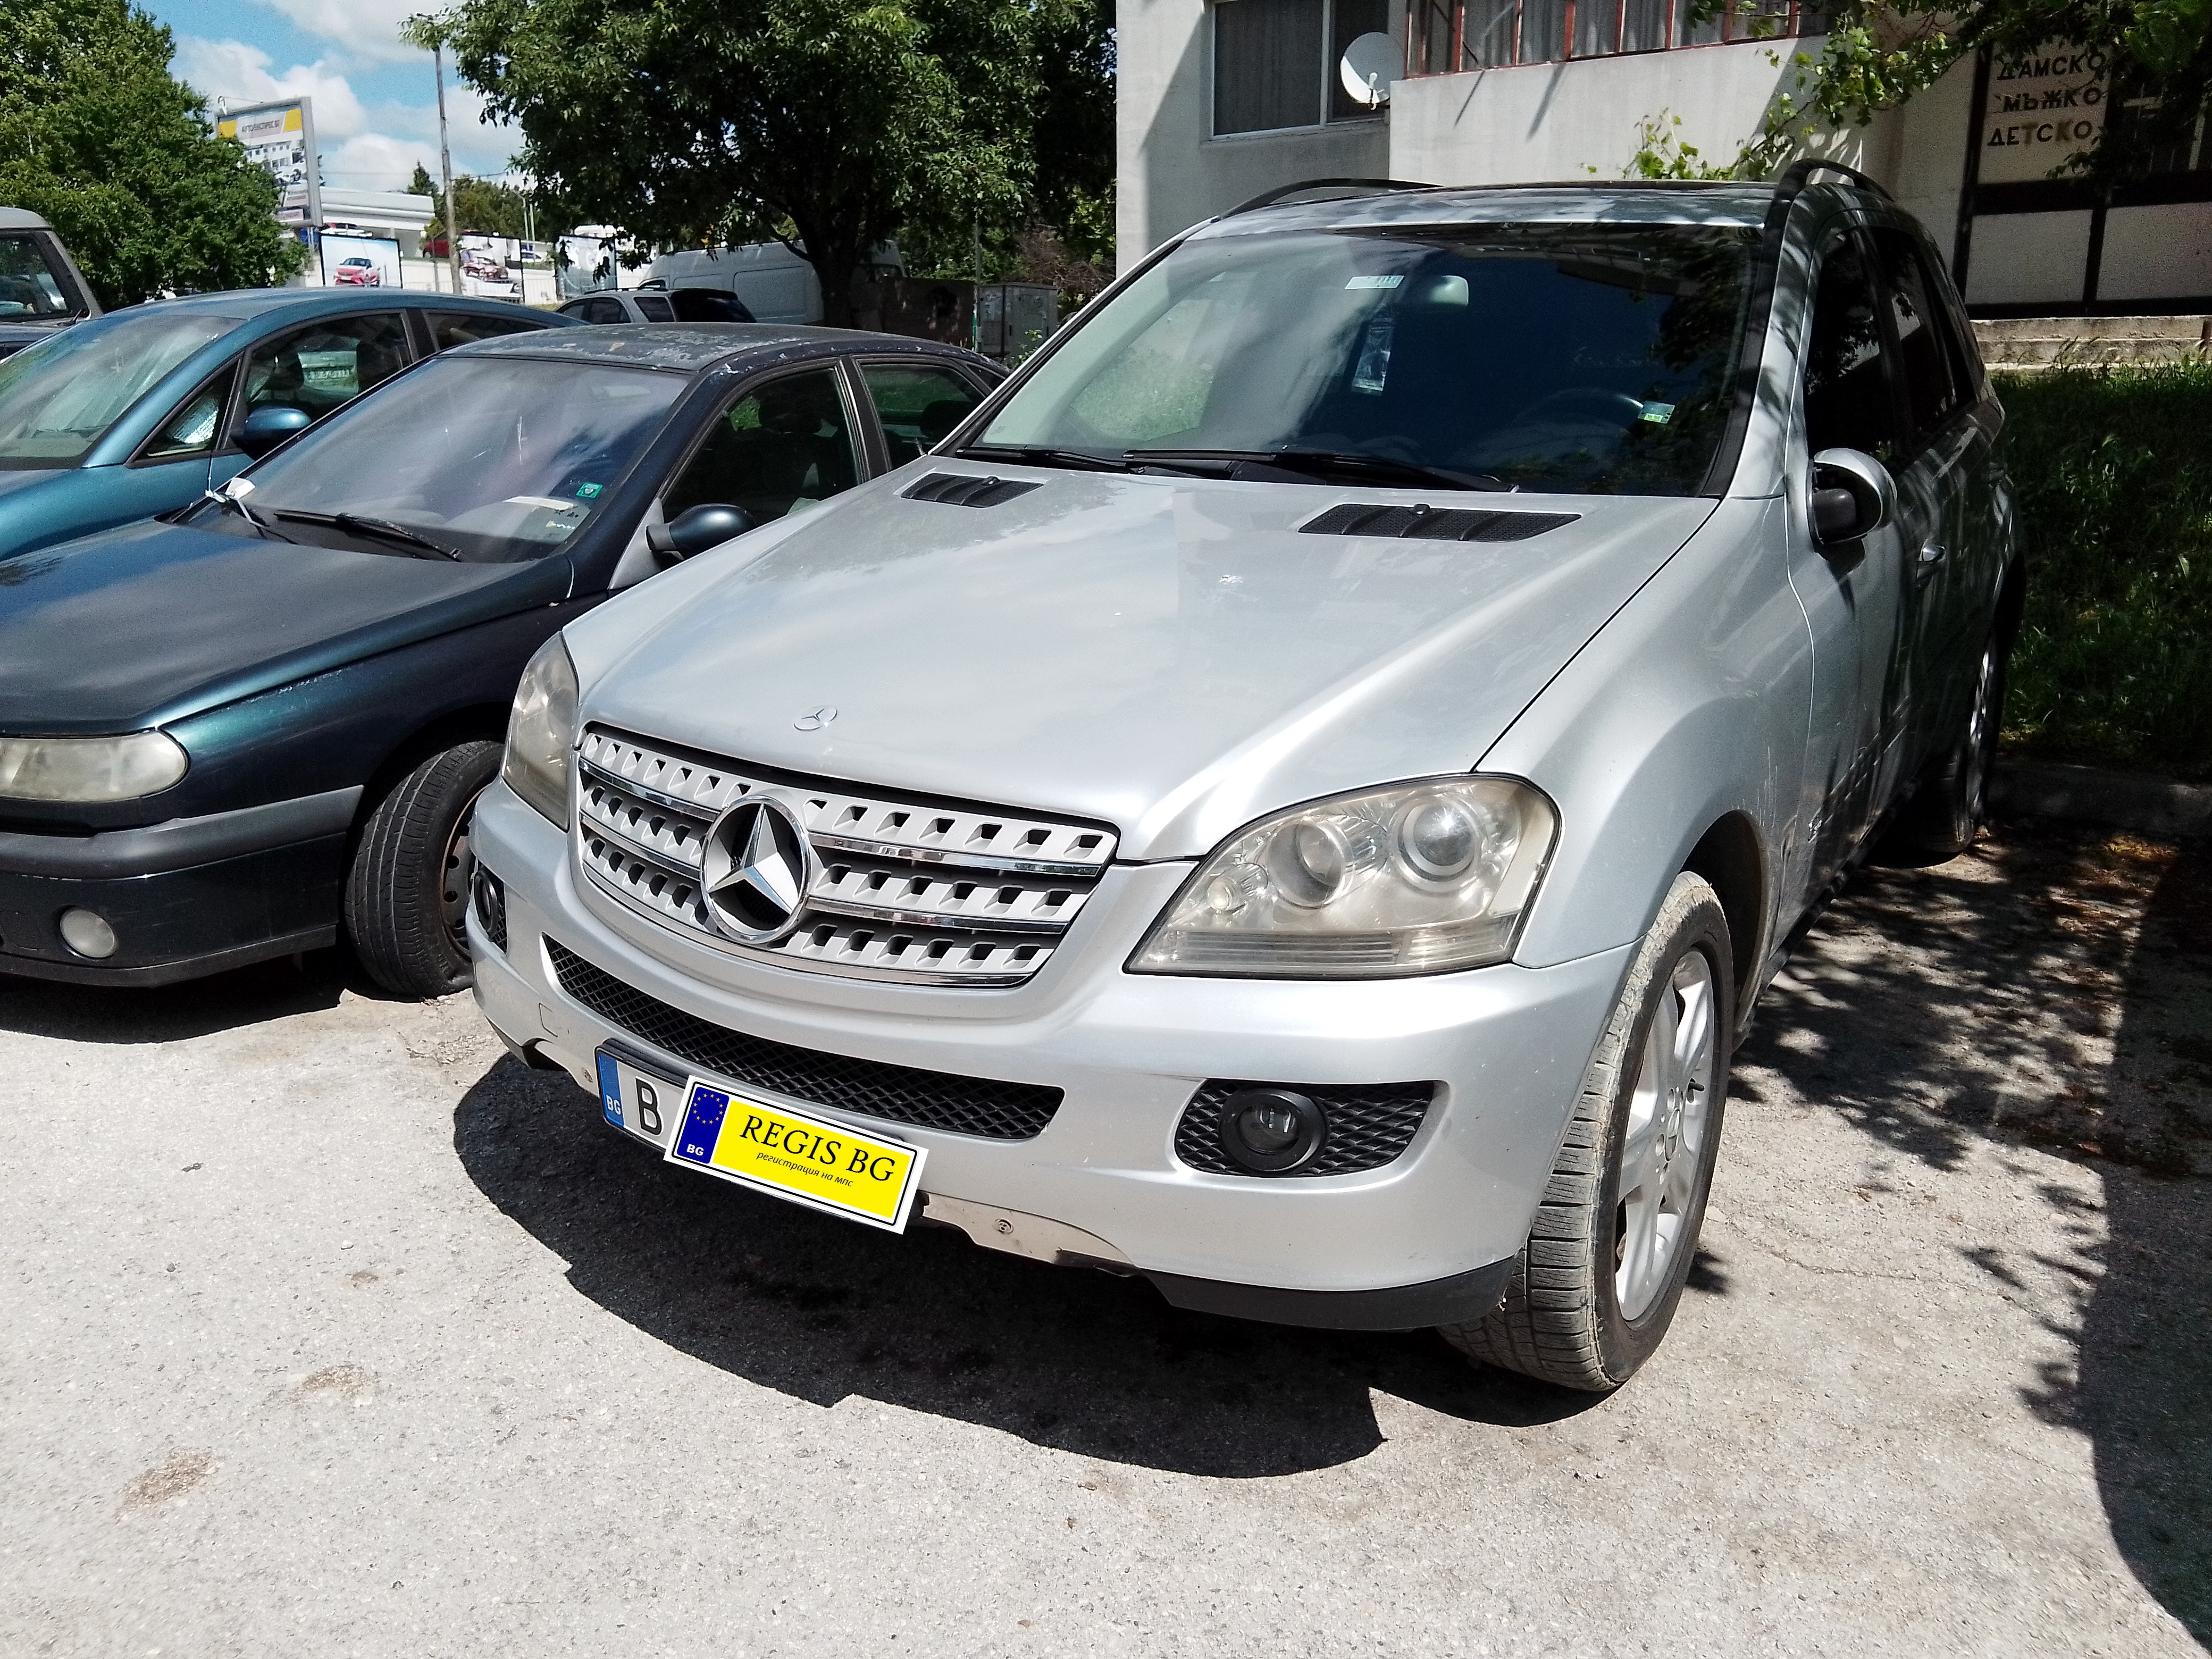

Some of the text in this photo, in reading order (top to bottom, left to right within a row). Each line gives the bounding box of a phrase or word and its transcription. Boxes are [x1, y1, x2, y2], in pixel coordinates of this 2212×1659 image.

[1997, 53, 2106, 80] ДАМСКО
[2003, 87, 2101, 112] МЪЖКО
[1987, 120, 2093, 146] ДЕТСКО
[606, 1077, 663, 1135] BG B
